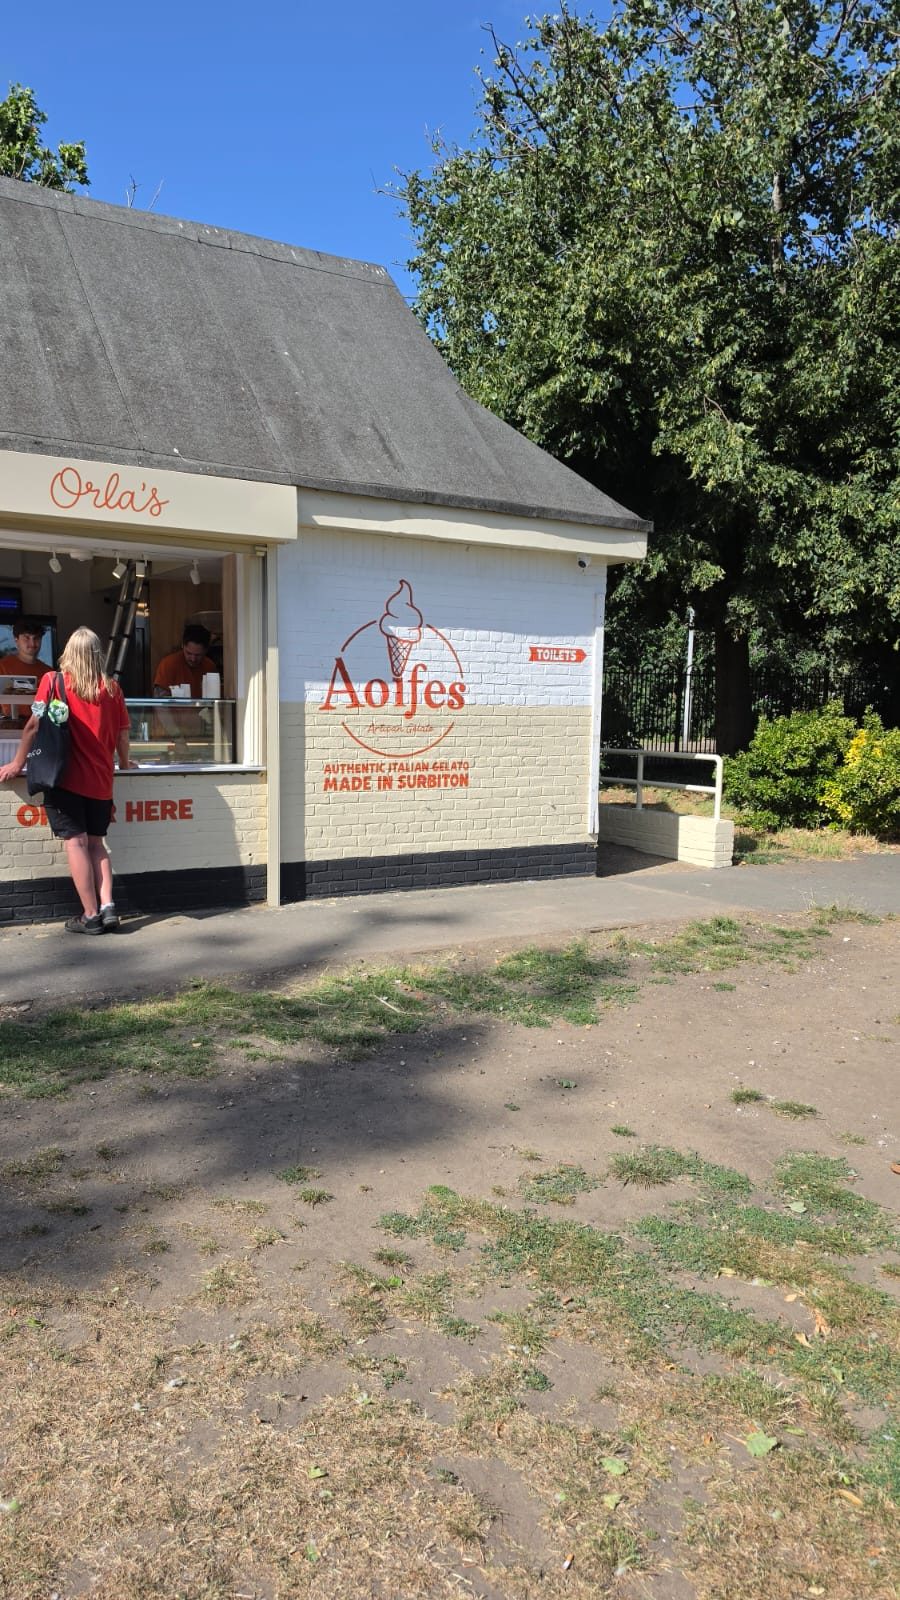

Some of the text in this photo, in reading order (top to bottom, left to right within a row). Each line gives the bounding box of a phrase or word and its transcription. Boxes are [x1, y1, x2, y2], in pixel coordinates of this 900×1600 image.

[50, 467, 170, 517] Orla's
[536, 648, 577, 661] TOILETS
[319, 656, 467, 720] Aoifes
[323, 761, 470, 775] AUTHENTIC ITALIAN GELATO
[323, 773, 470, 792] MADE IN SURBITON
[125, 799, 194, 823] HERE
